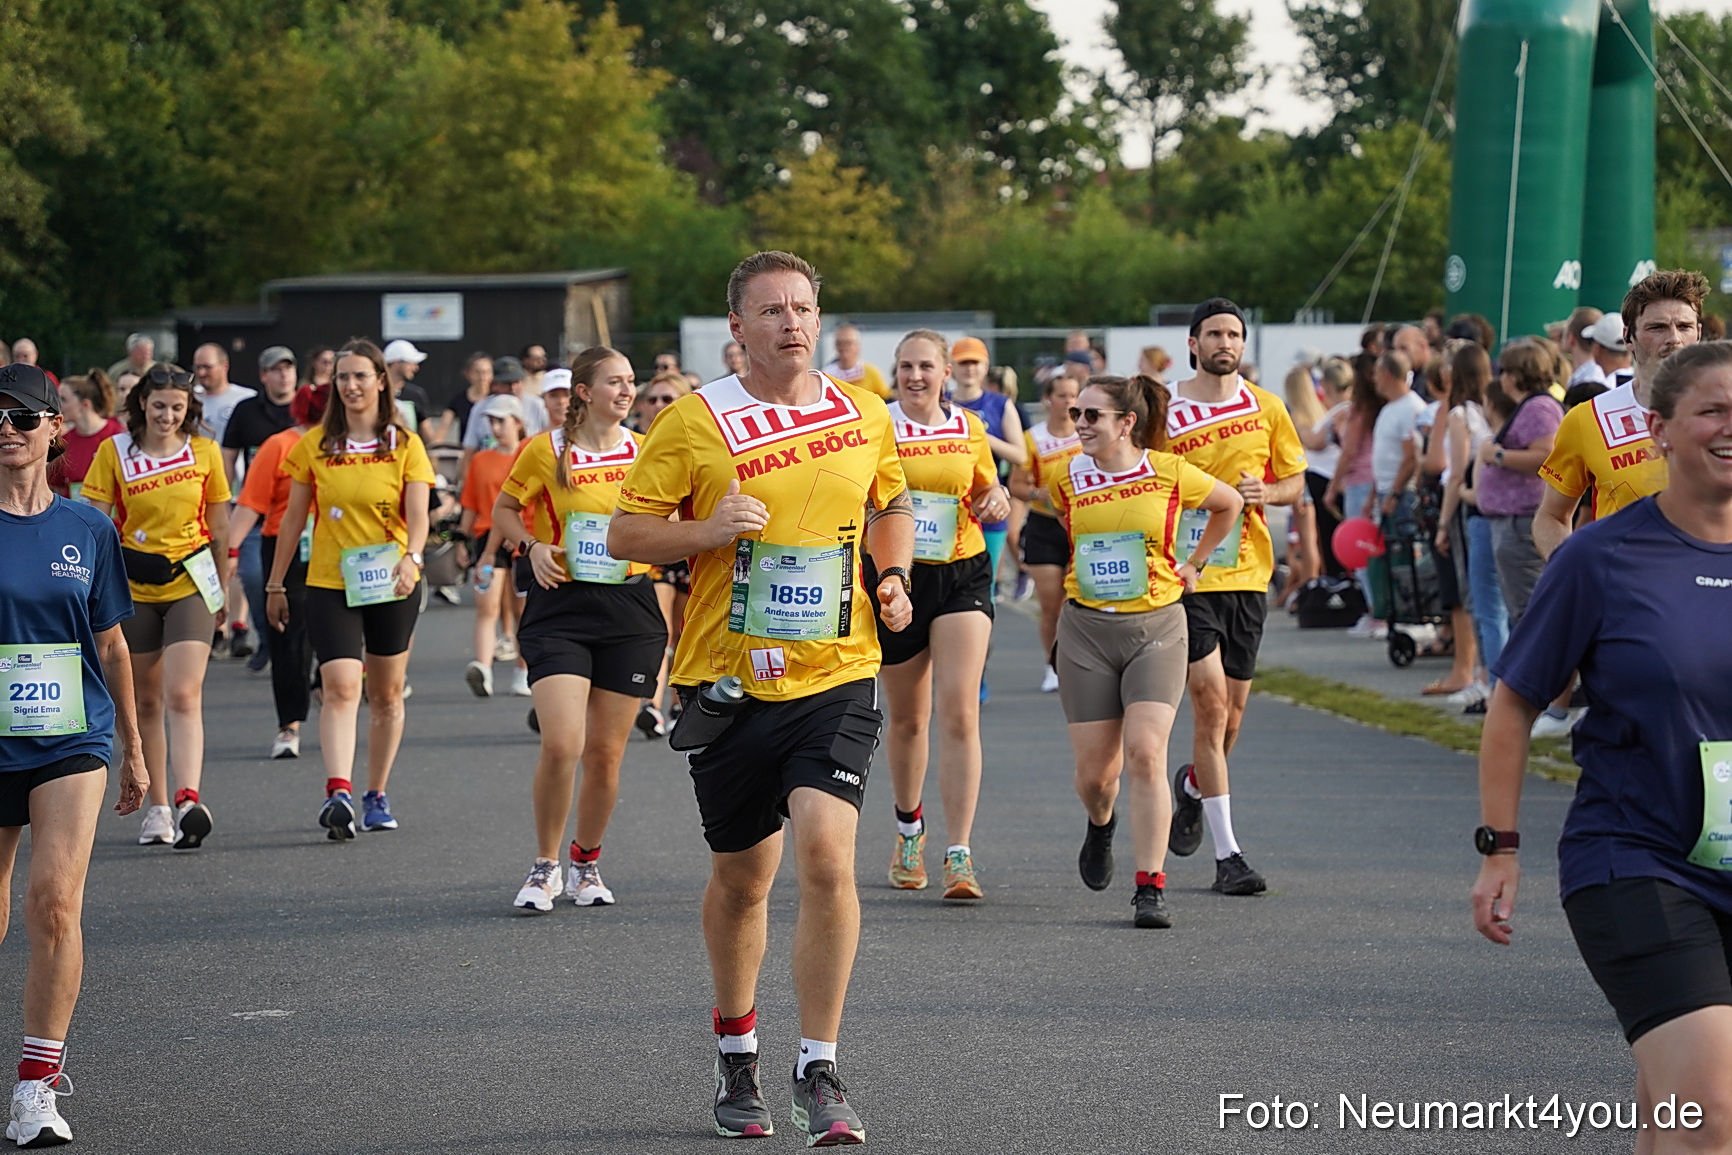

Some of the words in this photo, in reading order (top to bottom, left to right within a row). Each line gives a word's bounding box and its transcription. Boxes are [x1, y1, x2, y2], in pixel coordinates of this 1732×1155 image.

[1172, 432, 1214, 455] MAX
[1219, 419, 1264, 440] BÖGL
[736, 447, 802, 482] MAX
[807, 429, 868, 459] BÖGL
[897, 446, 933, 458] MAX
[937, 441, 971, 455] BÖGL
[326, 456, 357, 467] MAX
[127, 479, 161, 497] MAX
[164, 469, 200, 486] BÖGL
[604, 468, 628, 482] BÖ
[1076, 492, 1115, 509] MAX
[1120, 481, 1164, 499] BÖGL
[51, 562, 91, 578] QUARTZ
[358, 568, 388, 582] 1810
[1089, 560, 1130, 576] 1588
[51, 570, 90, 586] HEALTHCARE
[770, 584, 823, 605] 1859
[764, 606, 799, 618] Andreas
[802, 609, 826, 618] Weber
[840, 603, 848, 631] HILTL
[9, 682, 61, 701] 2210
[13, 706, 39, 716] Sigrid
[41, 706, 61, 714] Emra
[832, 769, 860, 786] JAKO
